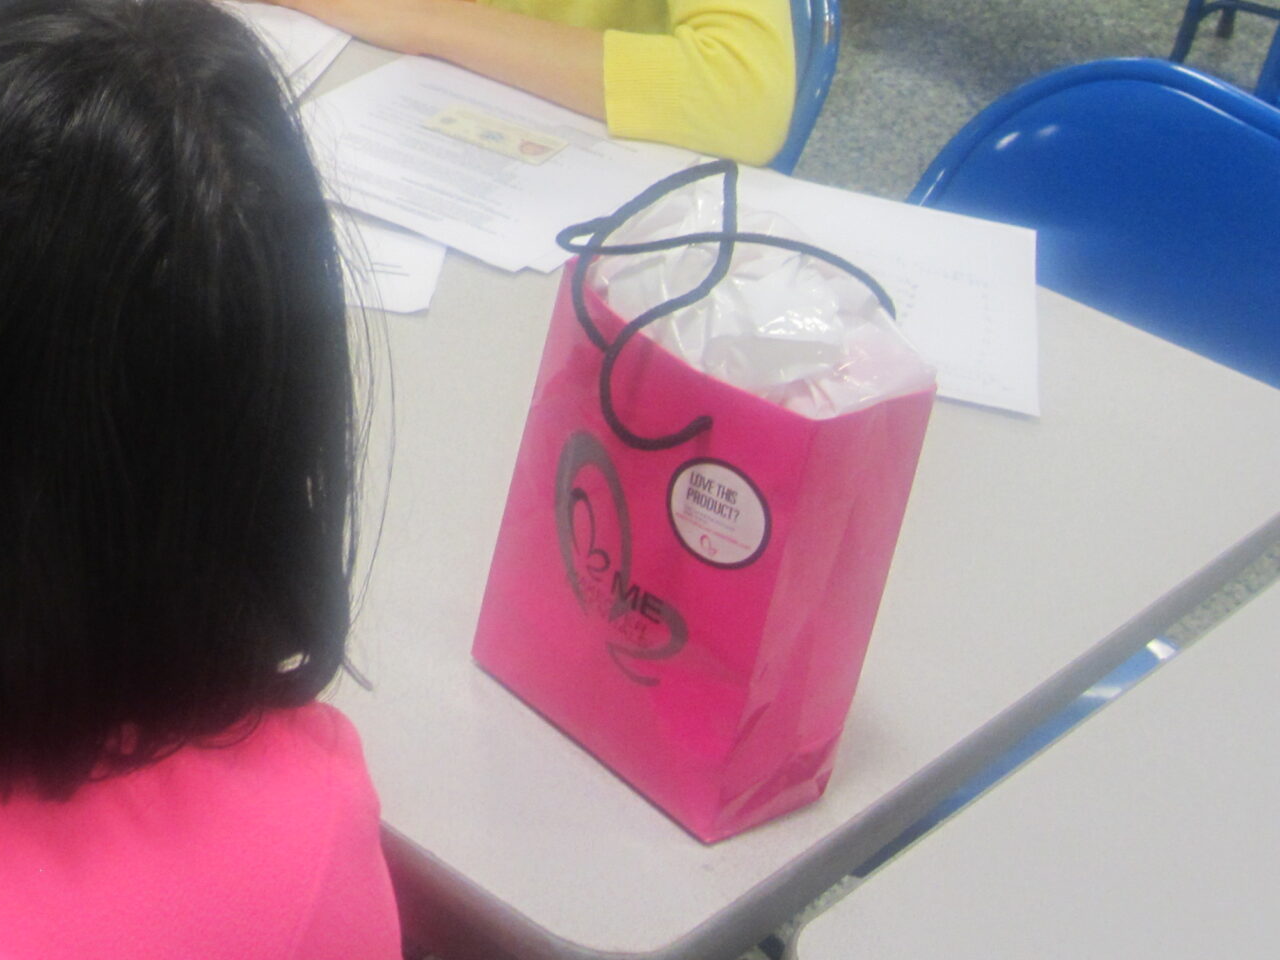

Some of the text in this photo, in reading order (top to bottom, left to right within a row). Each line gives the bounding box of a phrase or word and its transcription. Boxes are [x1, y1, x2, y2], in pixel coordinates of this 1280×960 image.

[686, 486, 741, 522] PRODUCT?
[689, 470, 738, 505] LOVE THIS
[610, 570, 665, 625] ME
